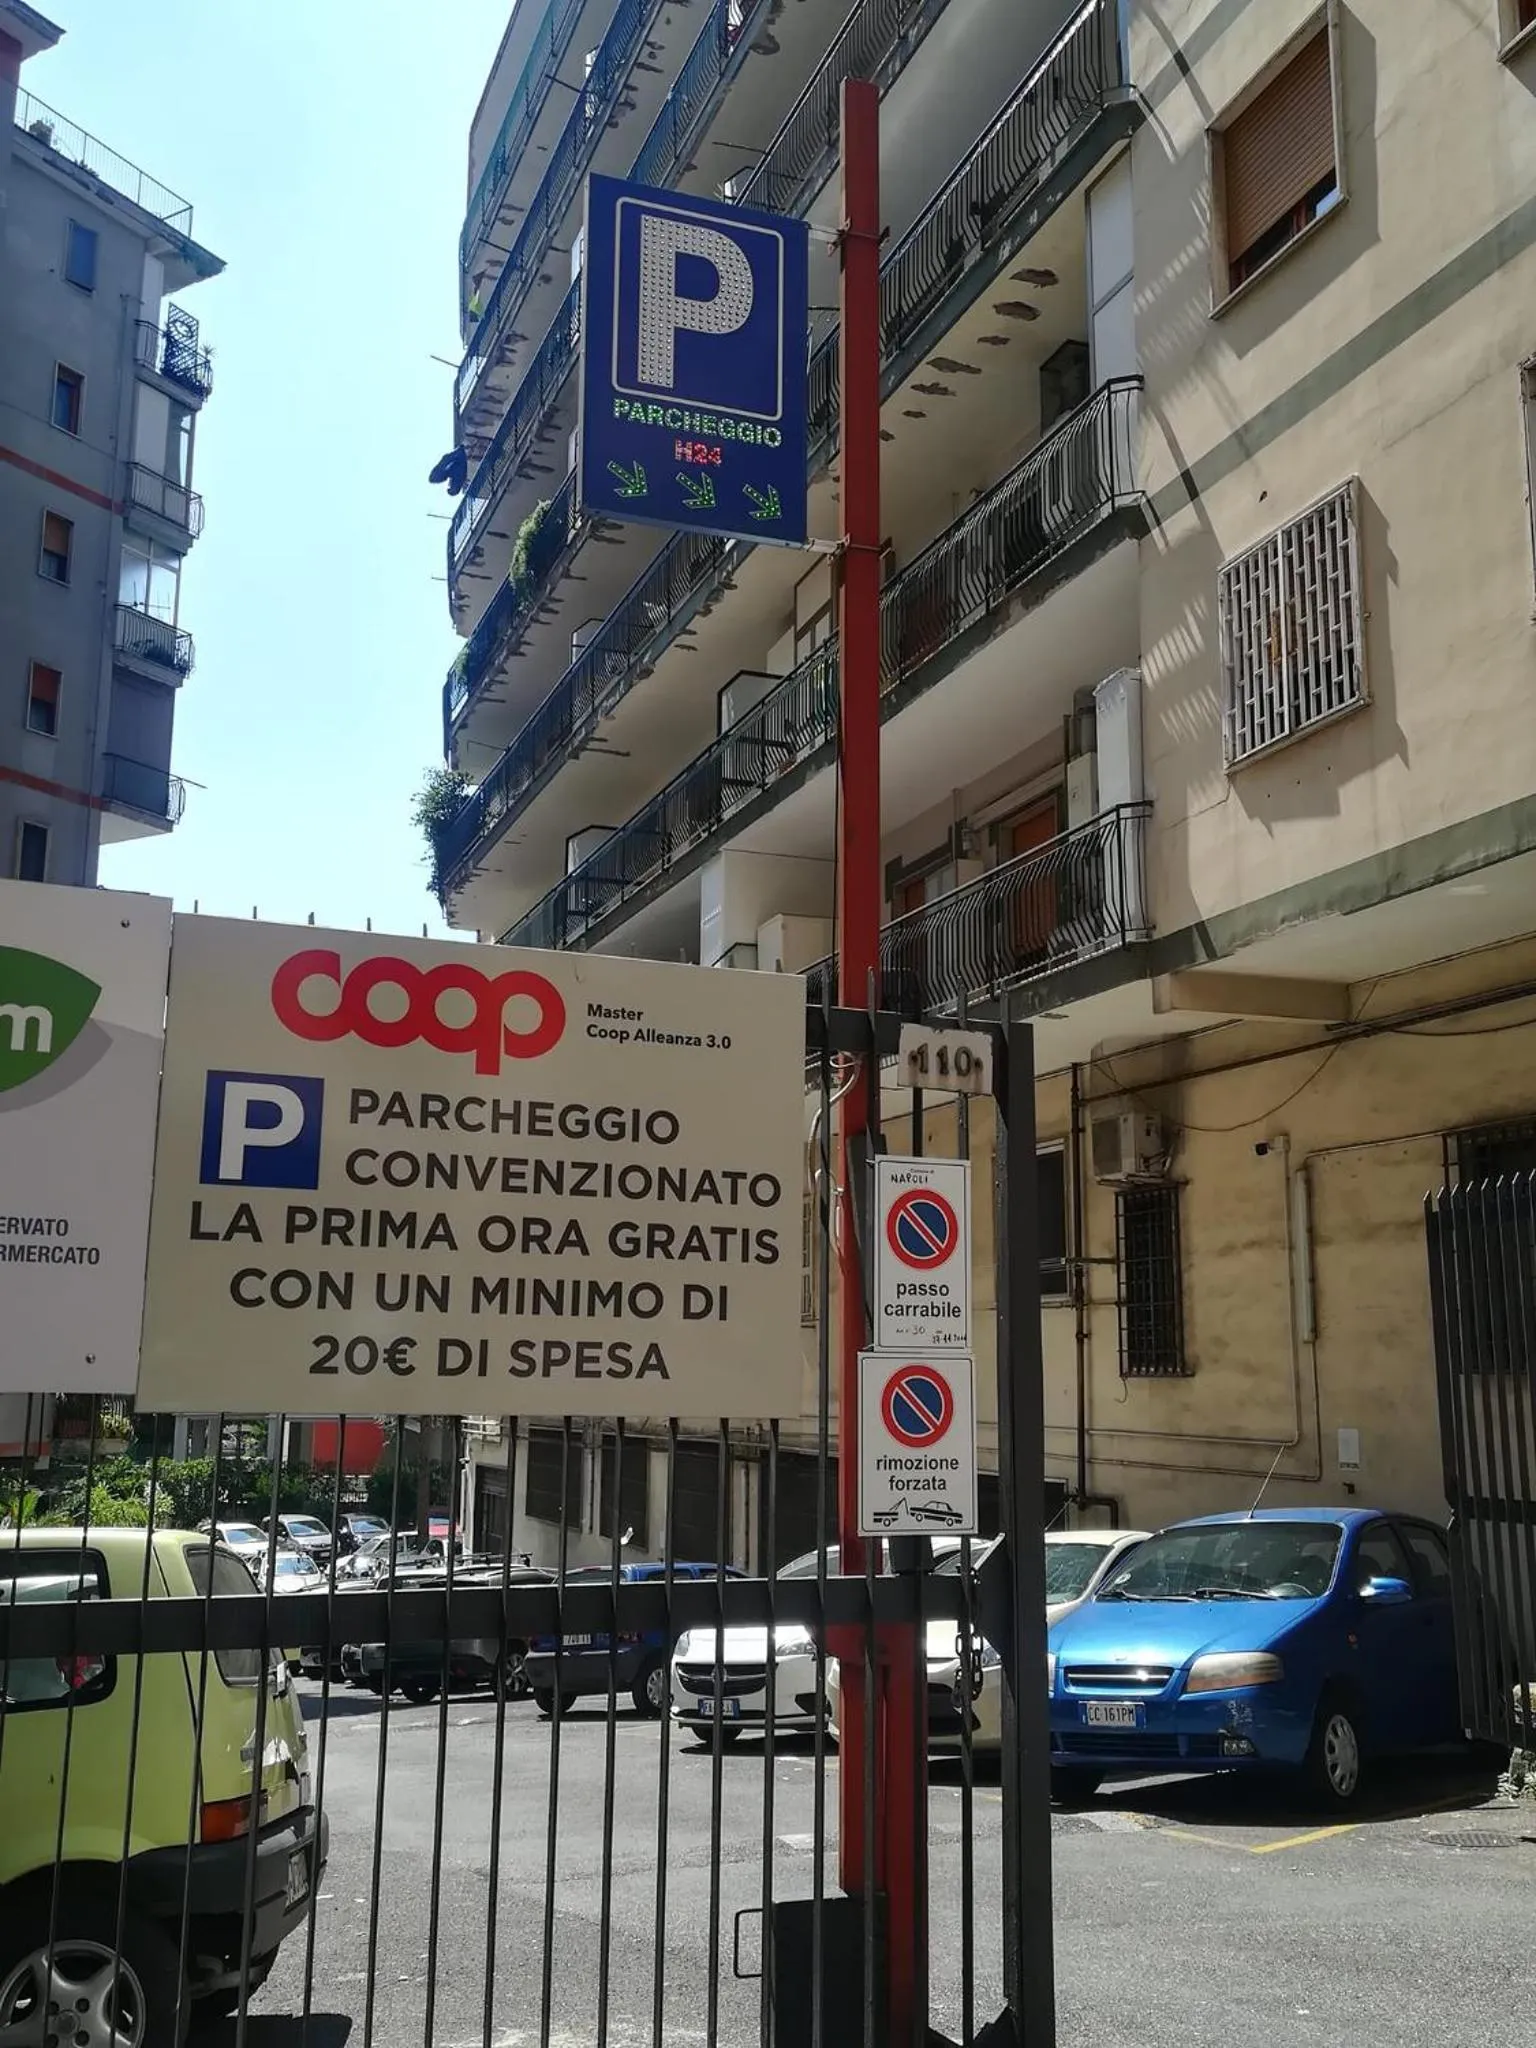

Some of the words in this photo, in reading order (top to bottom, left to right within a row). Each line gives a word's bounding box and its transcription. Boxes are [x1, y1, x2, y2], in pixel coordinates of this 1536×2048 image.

[637, 214, 753, 388] P
[613, 398, 783, 449] PARCHEGGIO
[674, 438, 722, 466] H24
[586, 1003, 644, 1022] Master
[586, 1023, 630, 1044] Coop
[633, 1028, 702, 1047] Alleanza
[706, 1034, 732, 1050] 3.0
[916, 1042, 972, 1077] 110
[217, 1080, 305, 1181] P
[349, 1087, 680, 1145] PARCHEGGIO
[345, 1148, 782, 1208] CONVENZIONATO
[890, 1173, 929, 1184] NAPOLI
[189, 1200, 264, 1244] LA
[284, 1204, 459, 1251] PRIMA
[477, 1214, 591, 1257] ORA
[608, 1221, 780, 1265] GRATIS
[229, 1267, 355, 1311] CON
[375, 1272, 451, 1314] UN
[470, 1276, 664, 1320] MINIMO
[682, 1283, 728, 1322] DI
[896, 1281, 950, 1298] passo
[884, 1301, 961, 1318] carrabile
[308, 1334, 418, 1377] 20€
[437, 1338, 489, 1377] DI
[508, 1339, 671, 1380] SPESA
[876, 1455, 960, 1471] rimozione
[888, 1475, 947, 1491] forzata
